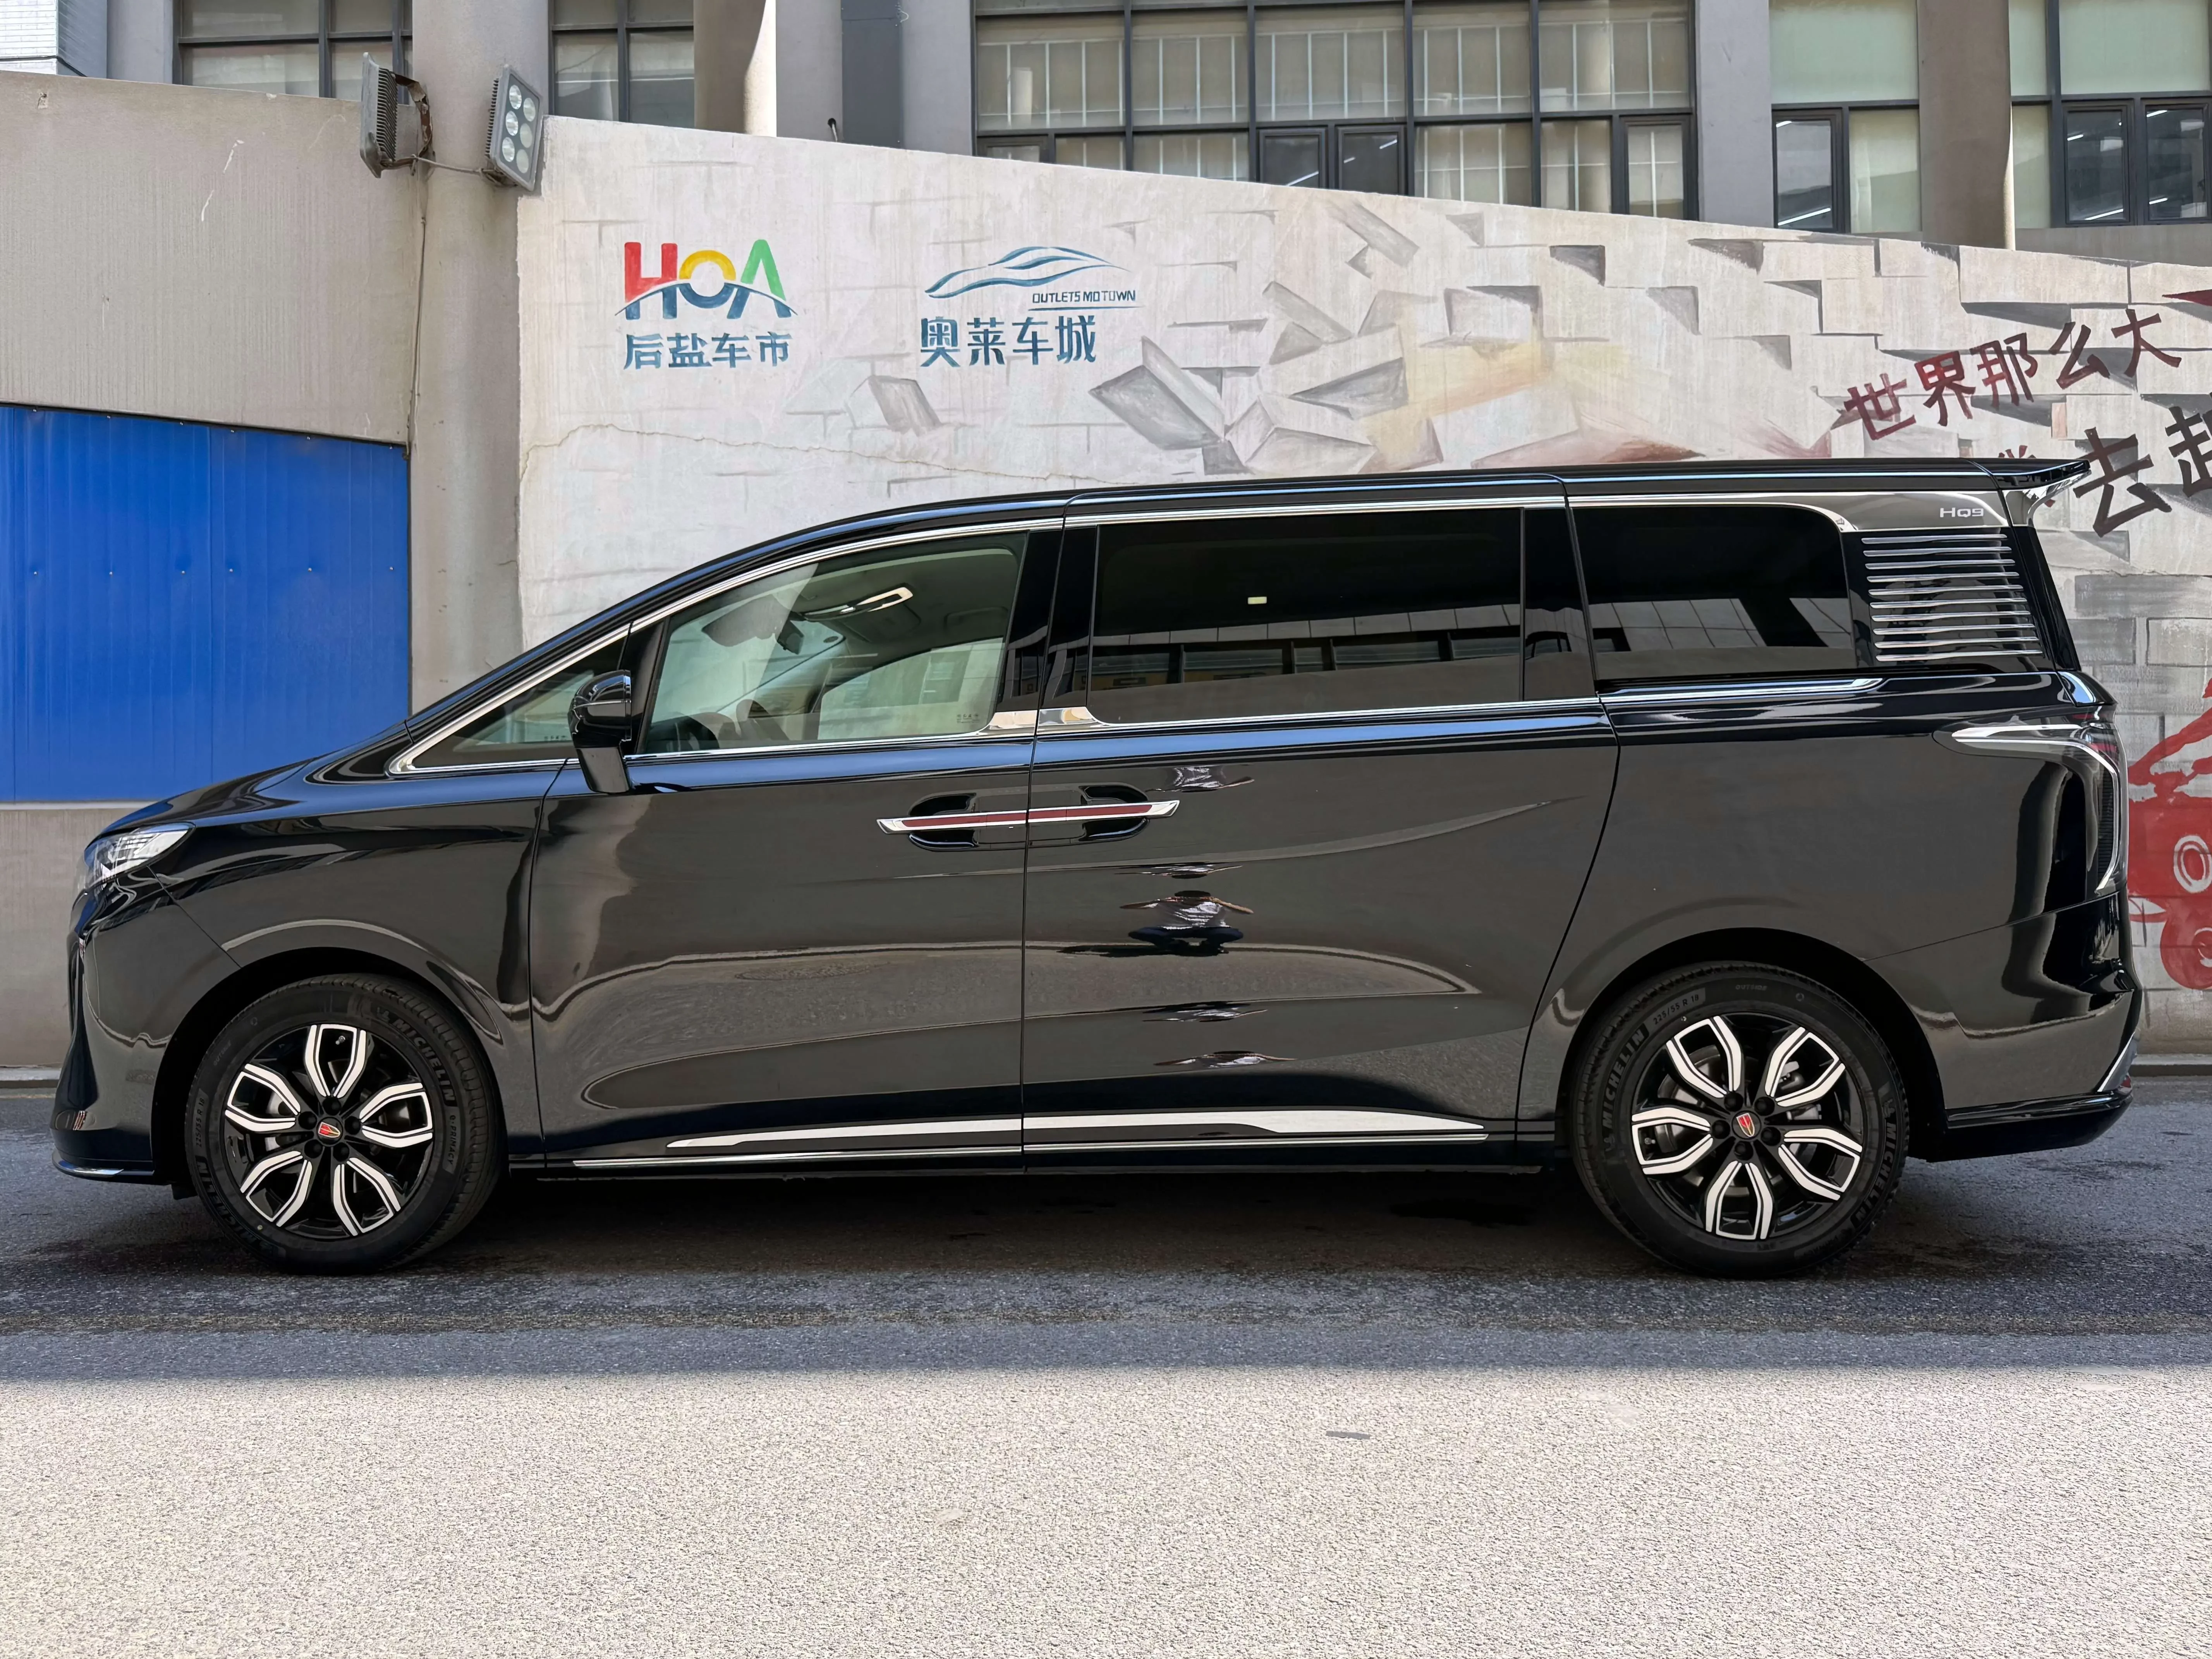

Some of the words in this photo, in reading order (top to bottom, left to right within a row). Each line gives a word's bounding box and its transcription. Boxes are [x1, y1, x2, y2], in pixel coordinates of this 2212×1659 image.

[624, 239, 792, 320] HOA
[1032, 291, 1080, 303] OUTLETS
[623, 331, 793, 369] 后盐车市
[920, 315, 1096, 368] 奥莱车城
[1843, 309, 2182, 440] 世界那么大
[1940, 507, 1984, 517] HQ9
[1653, 1003, 1680, 1025] 225/55
[1691, 994, 1699, 1003] 18
[392, 1018, 455, 1102] MICHELIN
[1602, 1029, 1645, 1128] MICHELIN
[198, 1097, 205, 1107] 18
[197, 1161, 256, 1245] MICHELIN
[1855, 1122, 1896, 1221] MICHELIN
